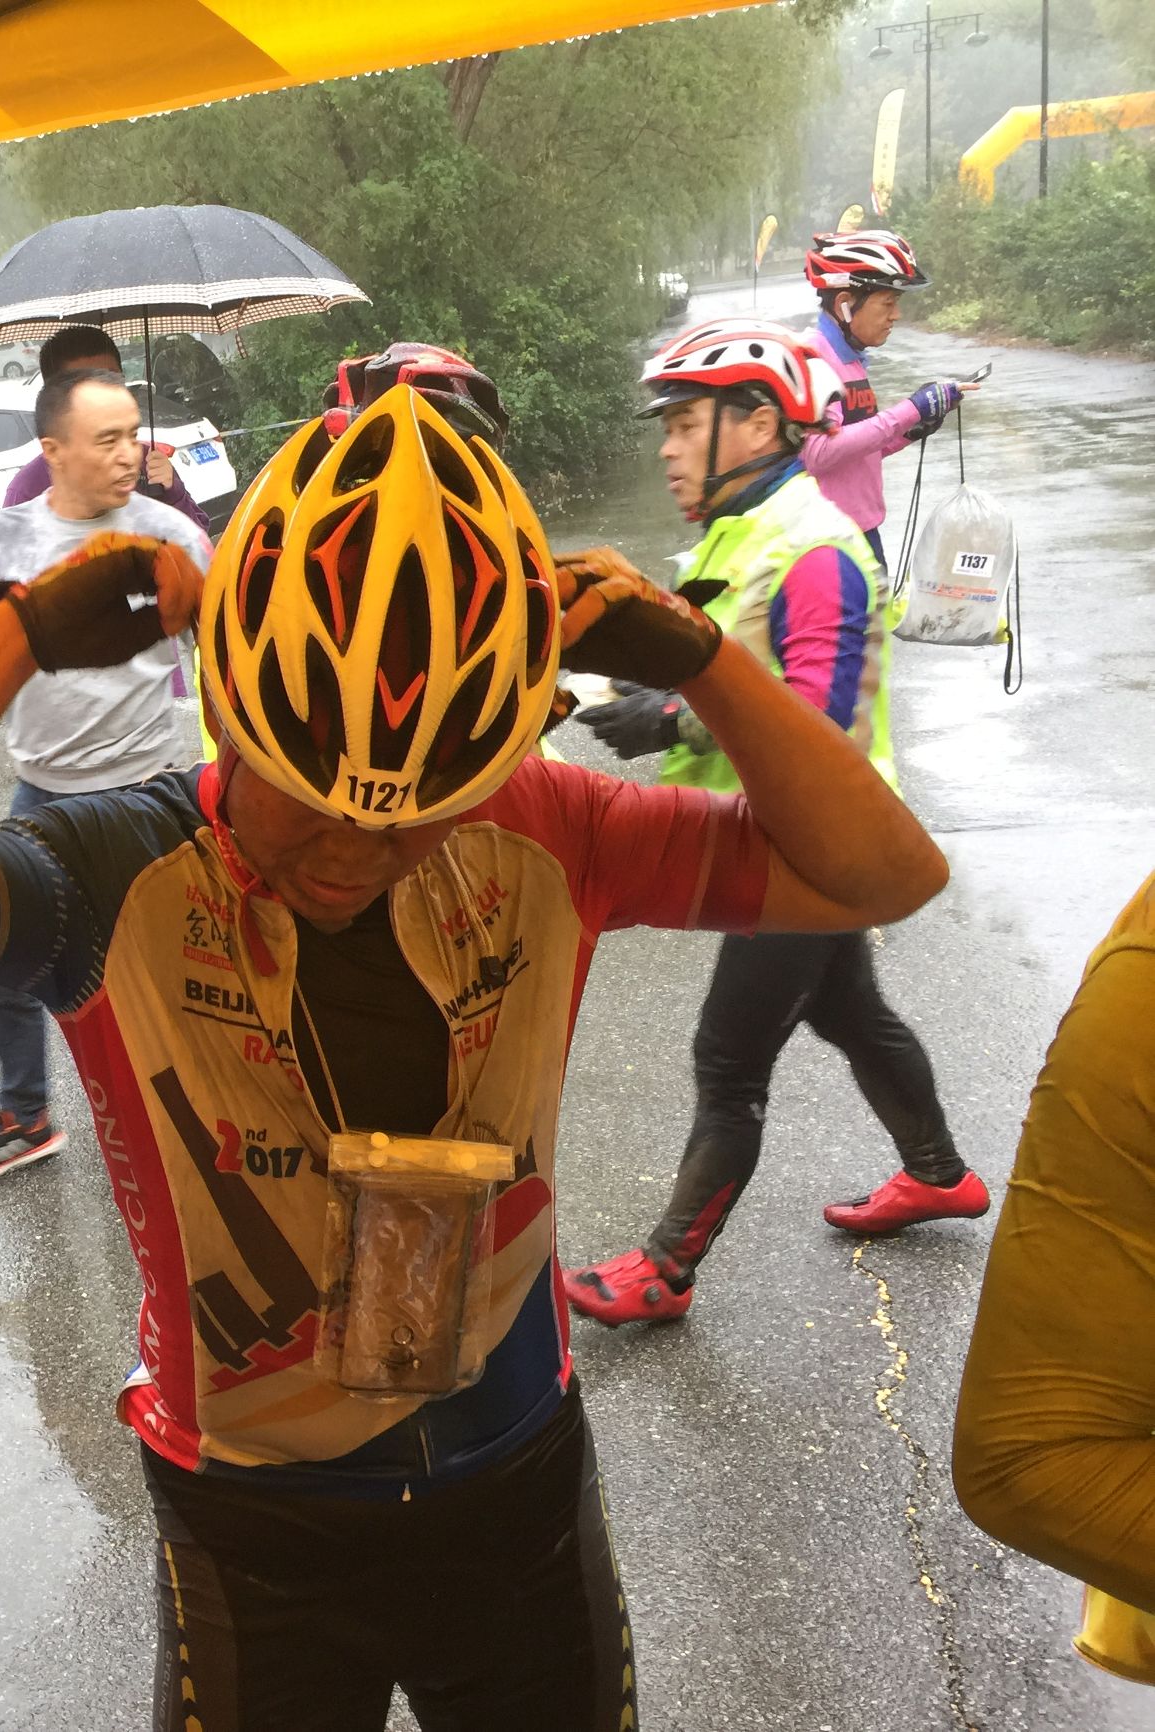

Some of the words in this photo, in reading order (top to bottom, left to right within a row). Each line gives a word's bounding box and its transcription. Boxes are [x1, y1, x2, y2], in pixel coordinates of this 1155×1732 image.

[960, 554, 988, 569] 1137
[347, 774, 413, 814] 1121
[86, 1078, 158, 1300] CYCLING
